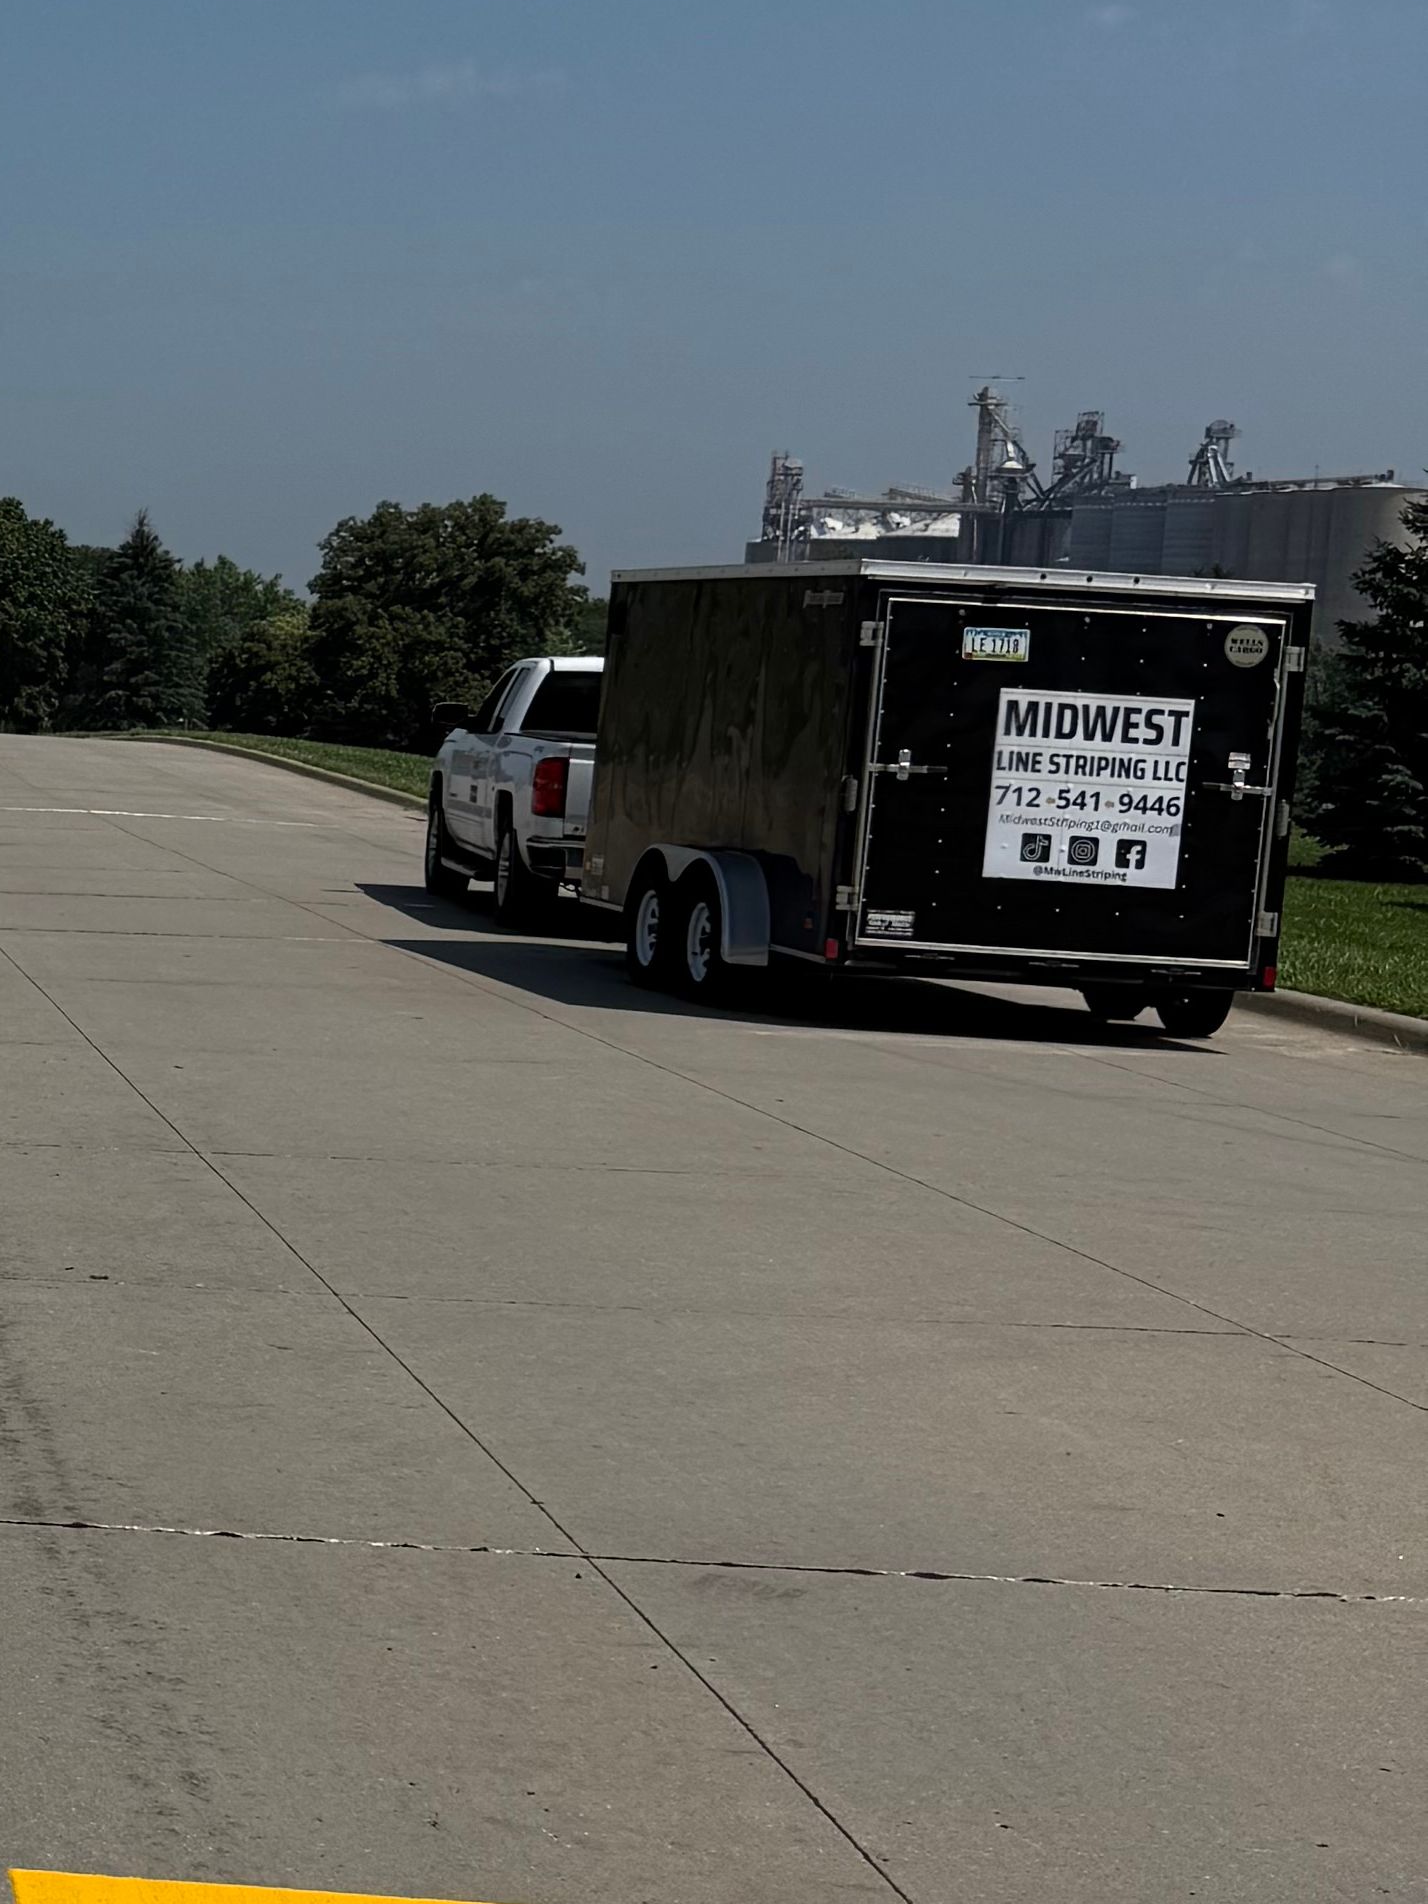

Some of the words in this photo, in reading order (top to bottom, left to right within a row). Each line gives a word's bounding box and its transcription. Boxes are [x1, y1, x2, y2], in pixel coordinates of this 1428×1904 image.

[1003, 700, 1190, 747] MIDWEST
[996, 750, 1043, 773] LINE
[1048, 753, 1147, 780] STRIPING
[1152, 759, 1187, 782] LLC
